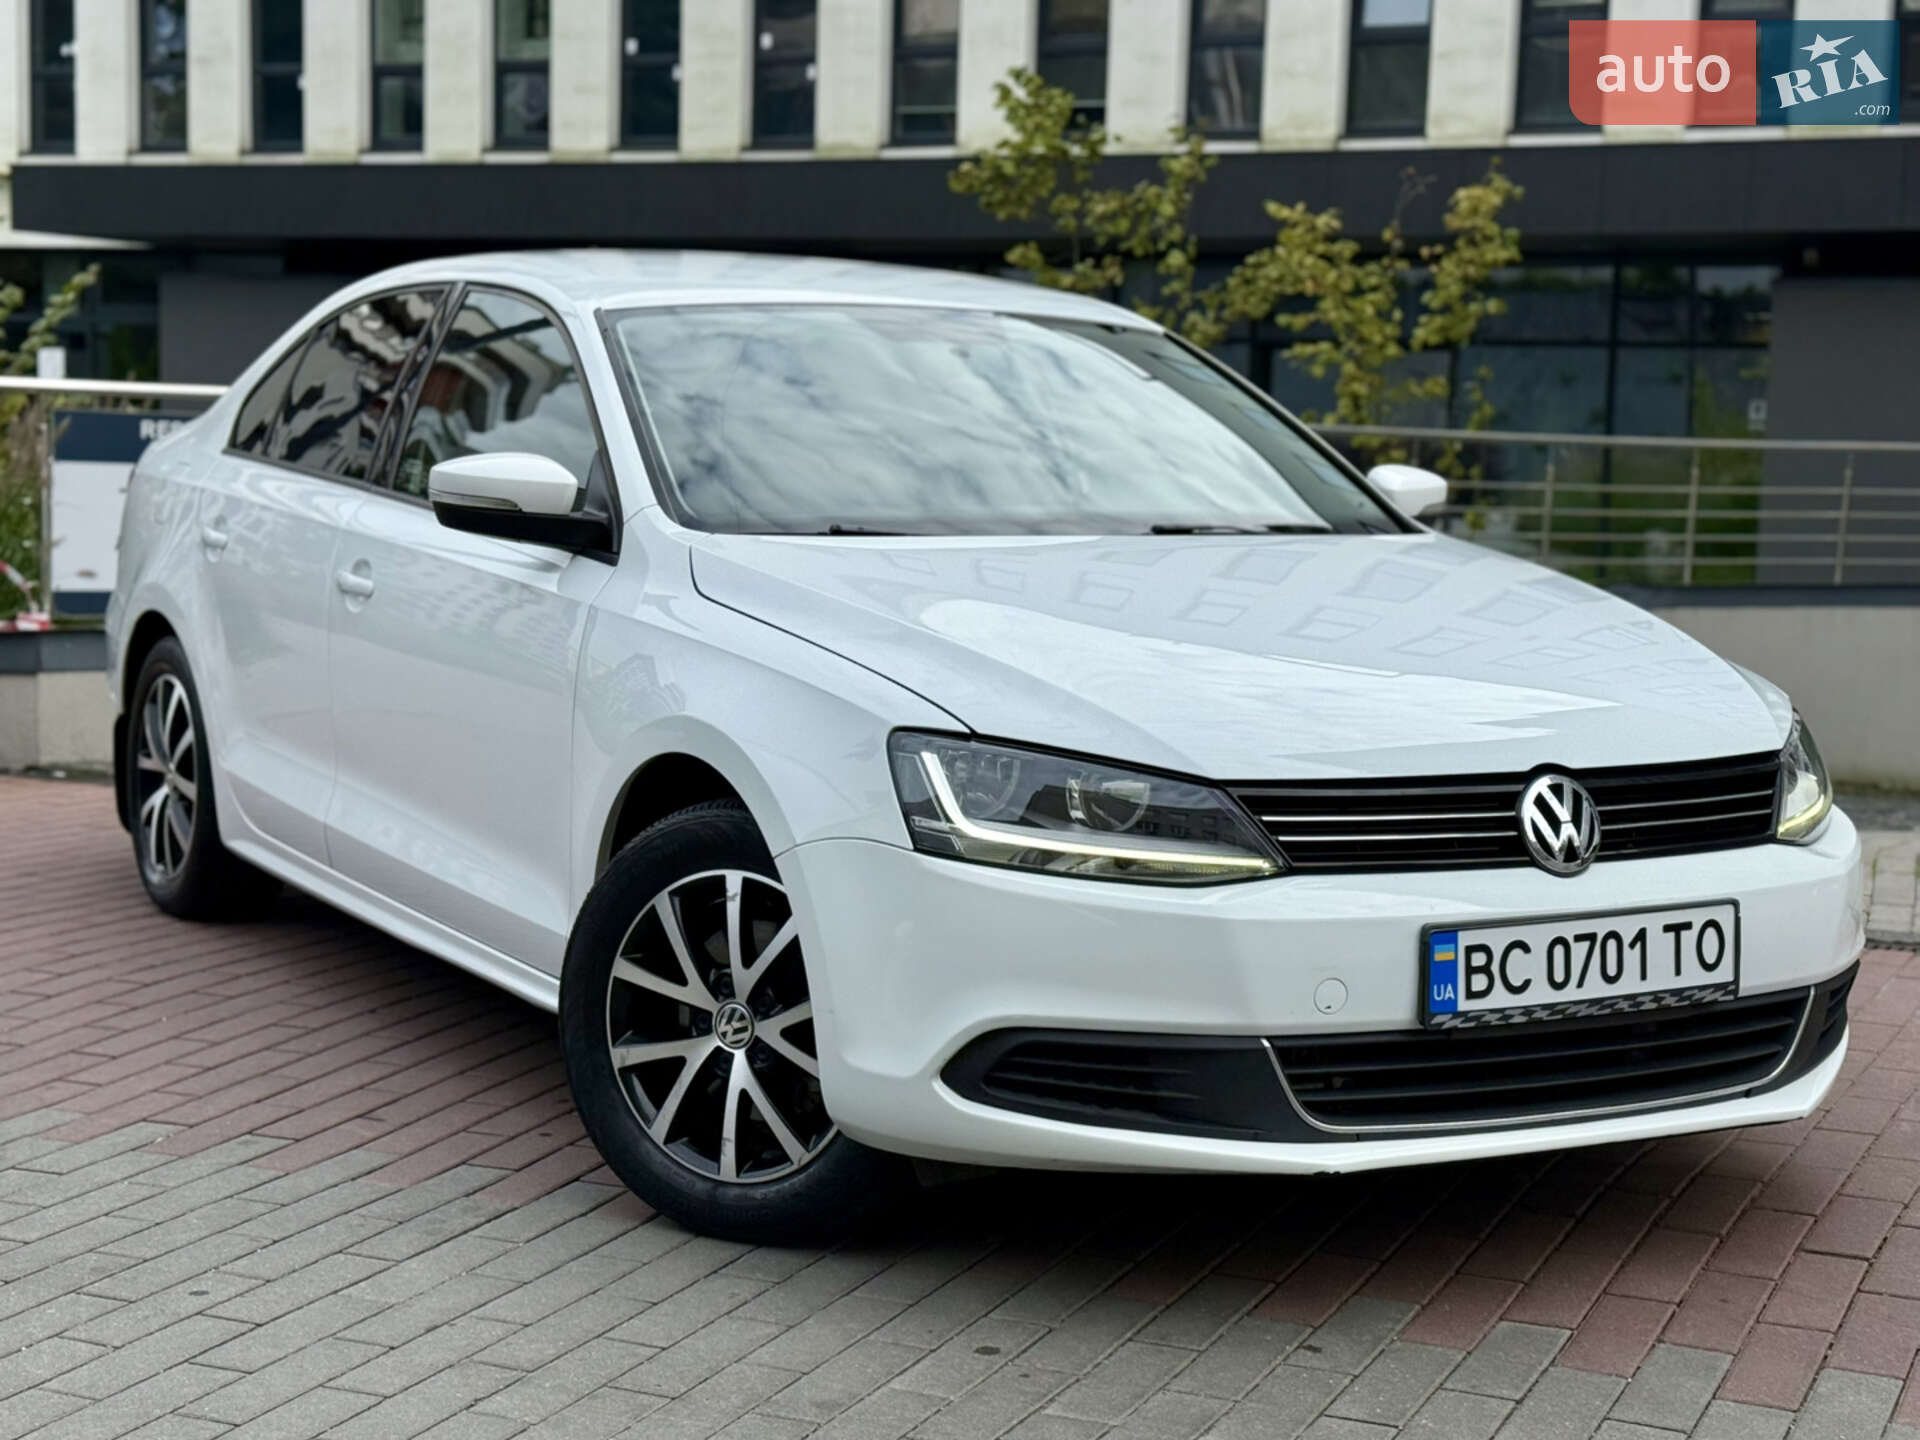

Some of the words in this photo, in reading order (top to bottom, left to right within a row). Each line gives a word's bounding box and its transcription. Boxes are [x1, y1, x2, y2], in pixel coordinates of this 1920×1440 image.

[1464, 939, 1532, 1000] BC
[1546, 926, 1648, 991] 0701
[1662, 918, 1726, 977] TO
[1433, 983, 1455, 1001] UA
